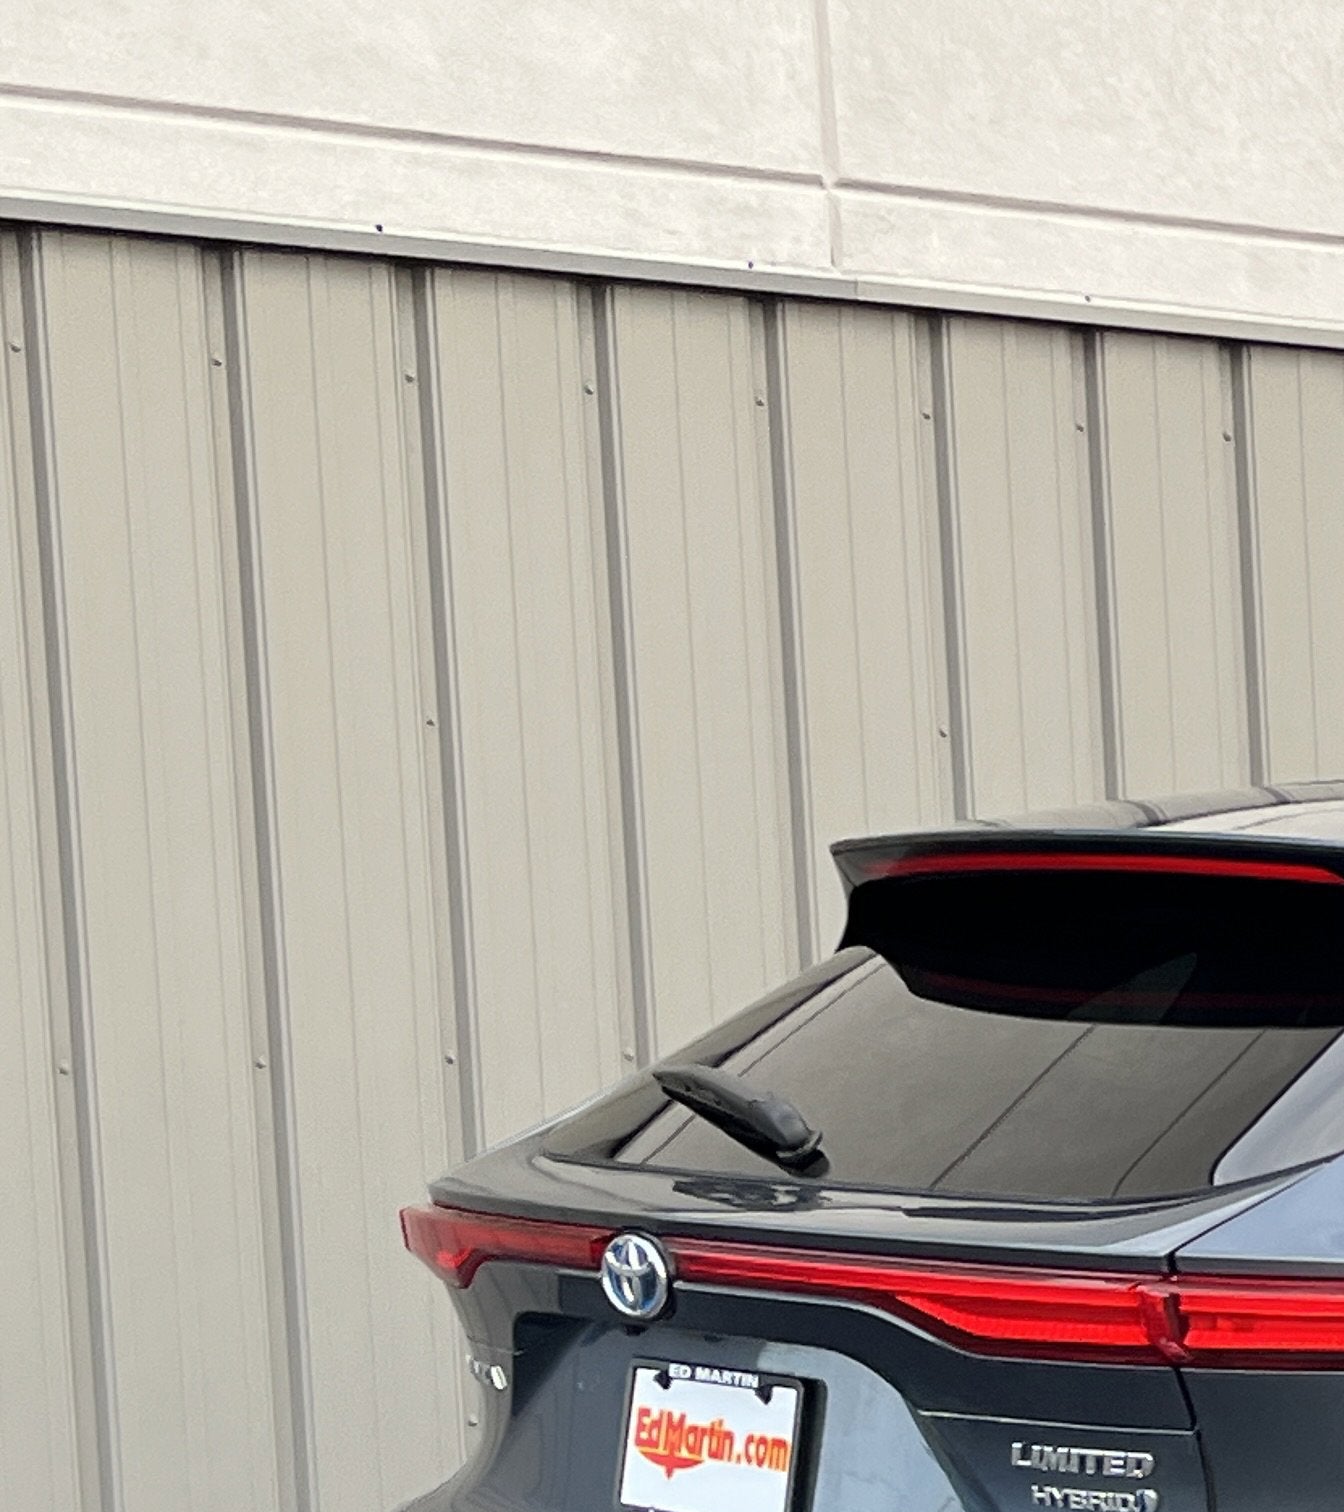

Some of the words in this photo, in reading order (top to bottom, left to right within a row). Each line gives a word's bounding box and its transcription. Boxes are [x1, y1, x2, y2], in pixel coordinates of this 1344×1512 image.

[669, 1363, 692, 1379] ED
[695, 1367, 759, 1388] MARTIN
[1011, 1441, 1155, 1479] LIMITED
[1030, 1484, 1140, 1512] HYBRID
